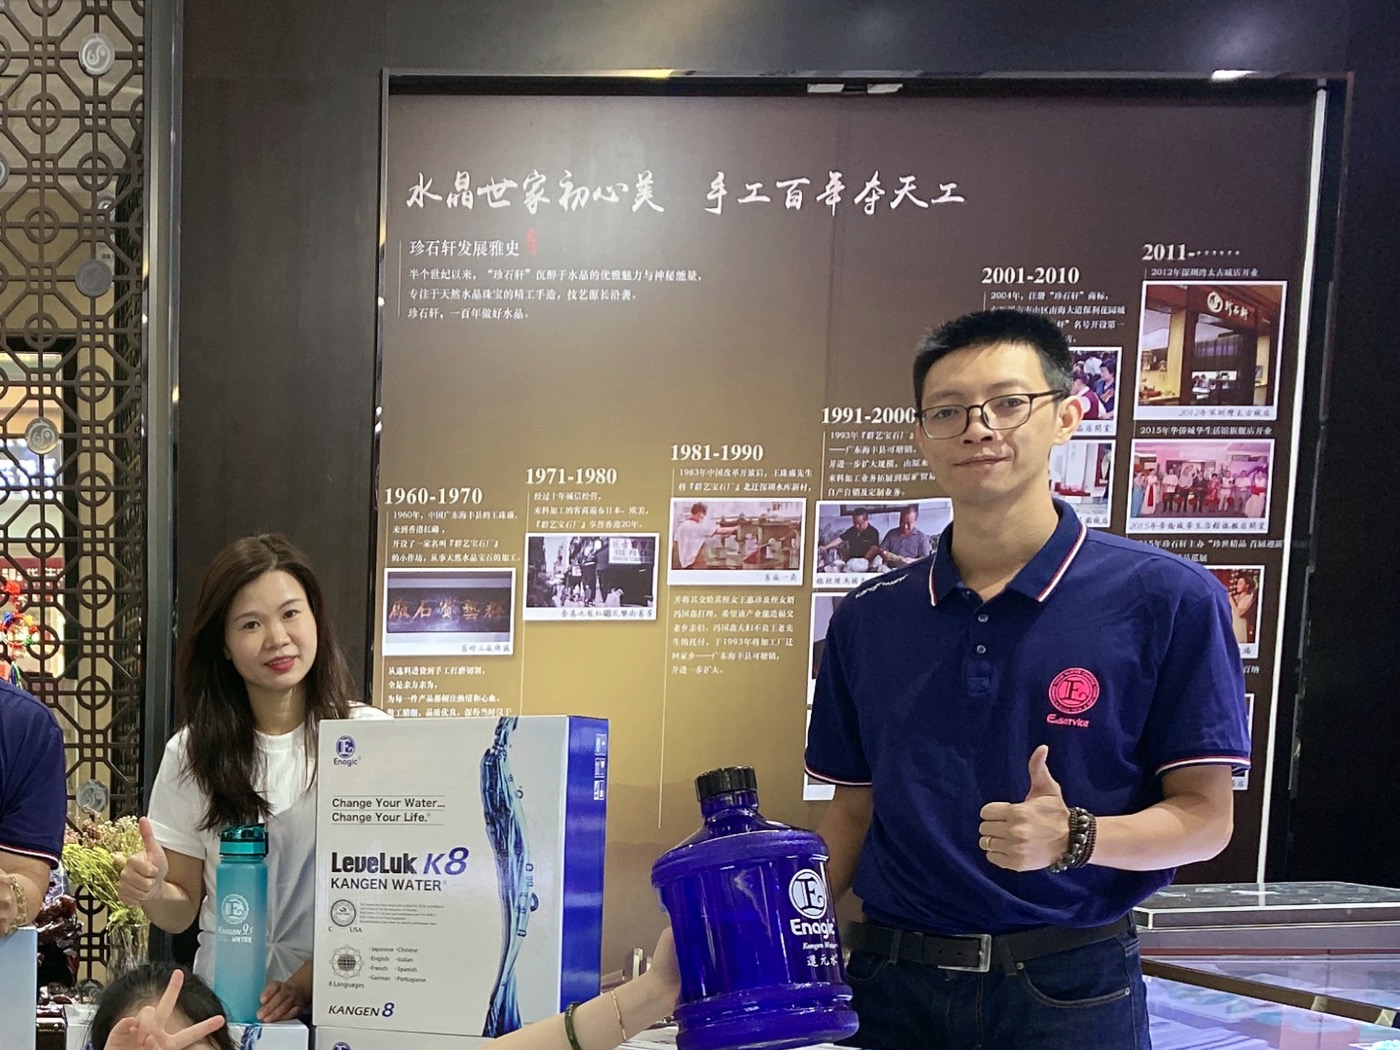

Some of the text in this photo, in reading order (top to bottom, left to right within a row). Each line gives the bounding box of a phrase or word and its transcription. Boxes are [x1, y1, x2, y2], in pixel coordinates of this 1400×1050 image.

[409, 240, 519, 256] 珍石轩发展雅史
[981, 267, 1079, 284] 2001-2010
[822, 407, 916, 424] 1991-2000
[671, 444, 764, 460] 1981-1990
[526, 468, 617, 485] 1971-1980
[384, 488, 482, 504] 1960-1970
[334, 758, 358, 767] Enagic
[331, 846, 469, 875] LeveLuk K8
[331, 878, 442, 890] KANGEN WATER
[328, 1002, 394, 1017] KANGEN 8
